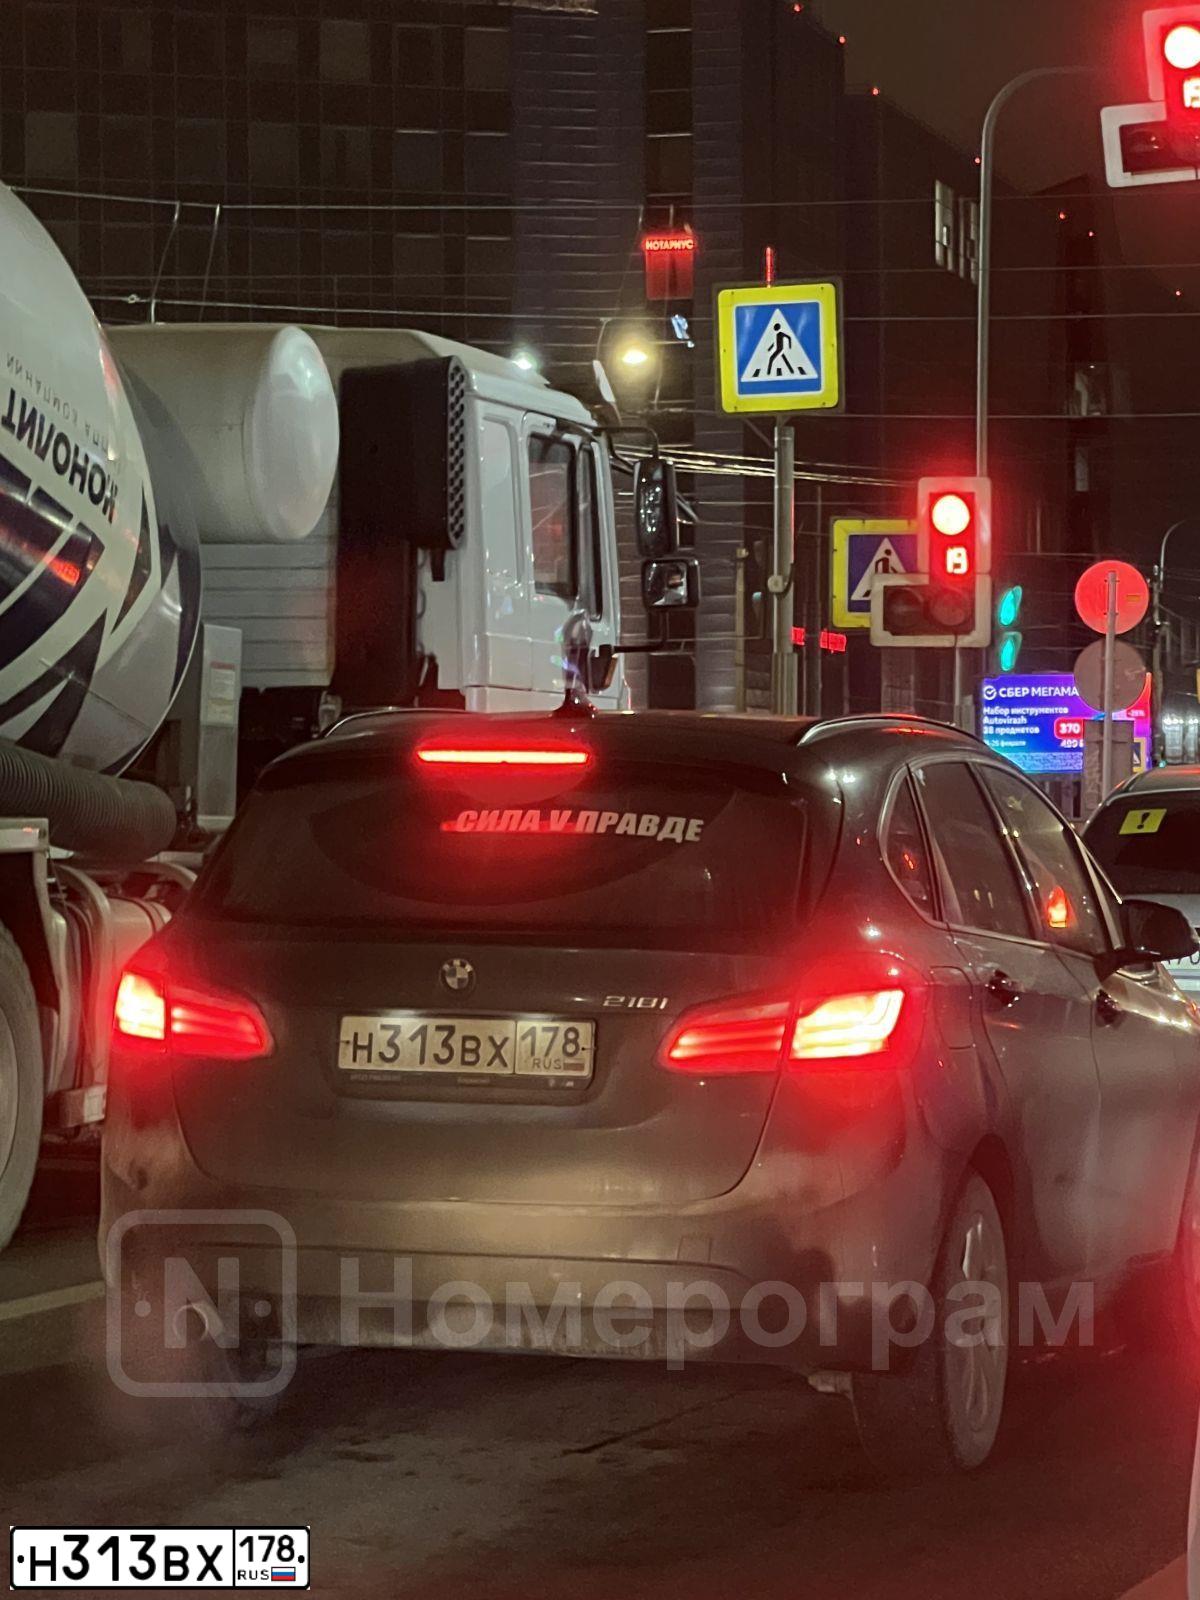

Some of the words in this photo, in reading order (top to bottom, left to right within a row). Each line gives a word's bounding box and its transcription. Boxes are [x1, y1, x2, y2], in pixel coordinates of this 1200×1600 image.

[645, 238, 695, 251] НОТАРИУС
[998, 687, 1030, 697] СБЕР
[1031, 686, 1080, 697] МЕГАМА
[983, 706, 1010, 717] Набор
[1011, 707, 1069, 716] инструментов
[1059, 722, 1081, 734] 370
[456, 809, 541, 833] СИЛА
[575, 810, 704, 844] ПРАВДЕ
[352, 1023, 510, 1068] Н313ВХ
[521, 1026, 581, 1058] 178
[532, 1057, 562, 1070] RUS
